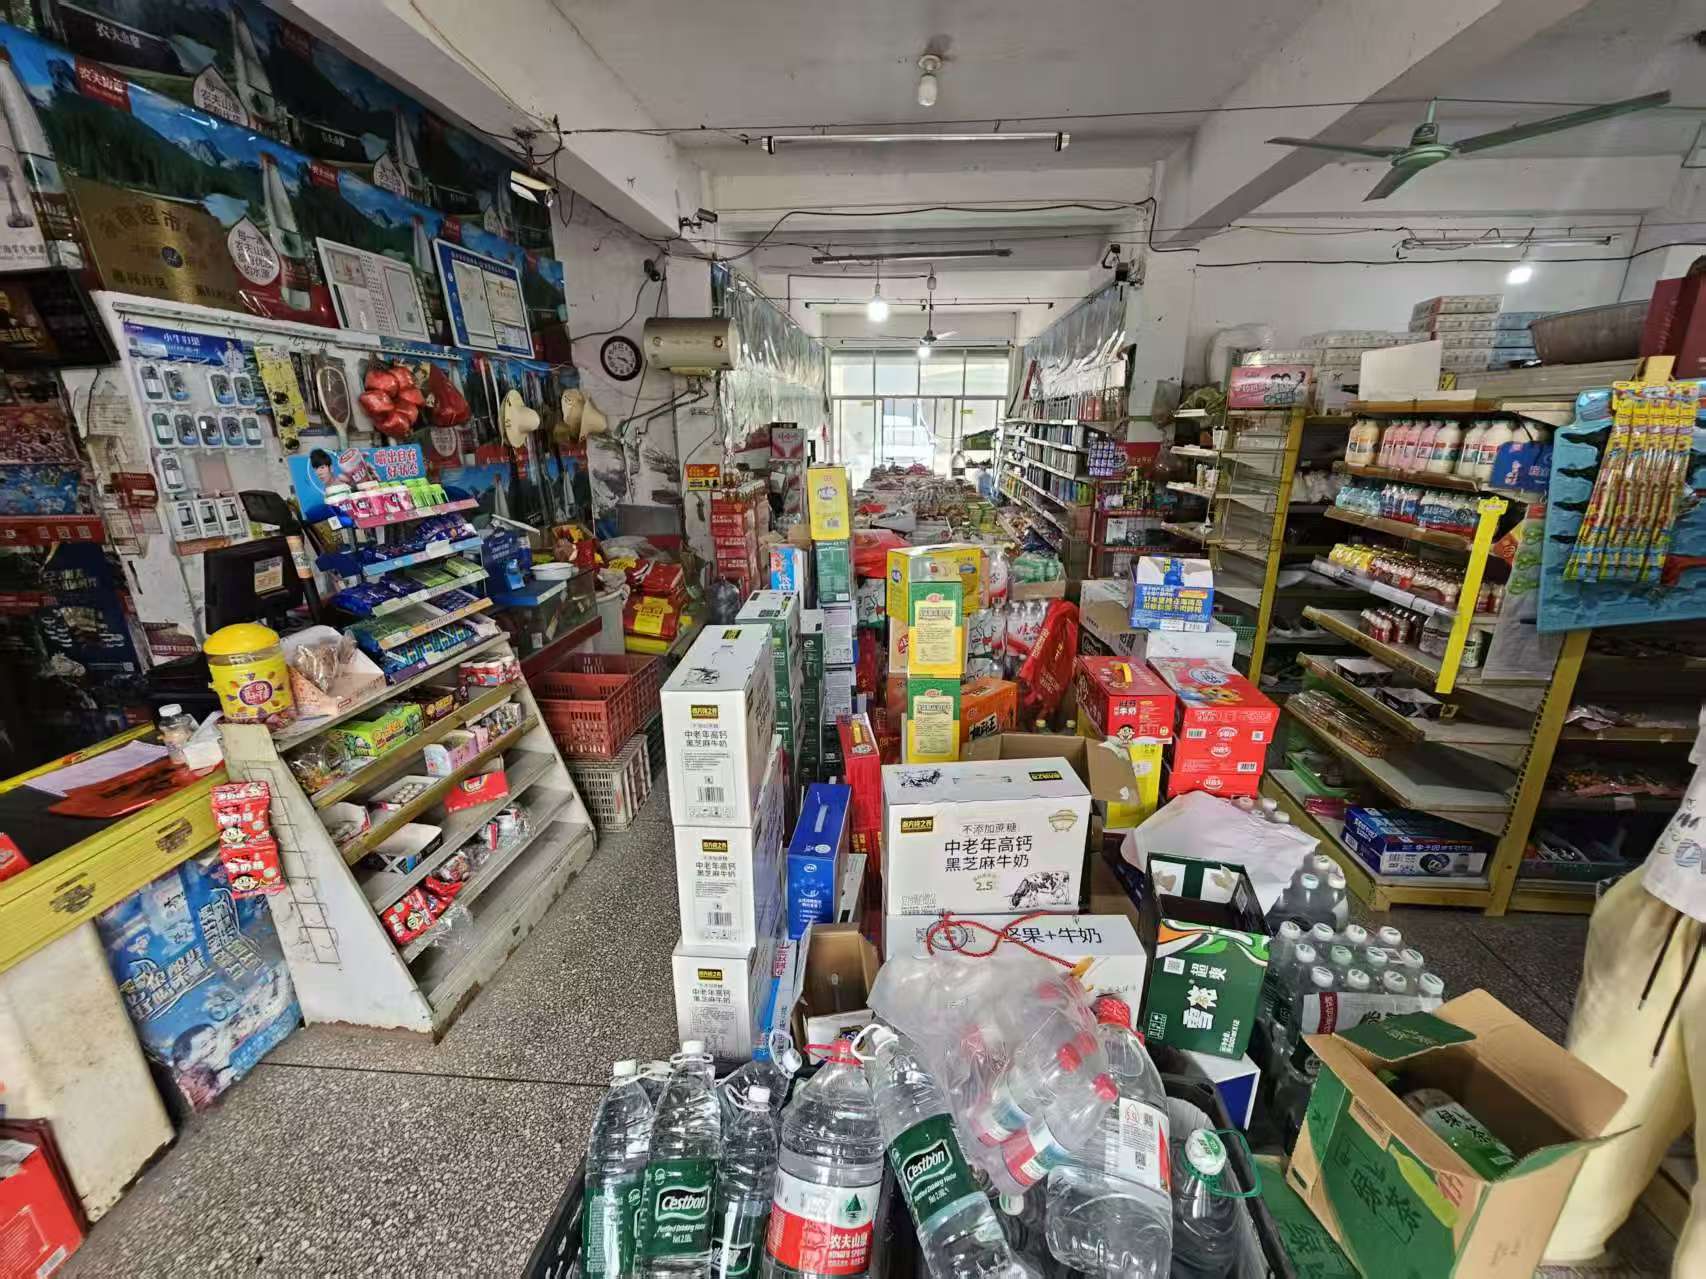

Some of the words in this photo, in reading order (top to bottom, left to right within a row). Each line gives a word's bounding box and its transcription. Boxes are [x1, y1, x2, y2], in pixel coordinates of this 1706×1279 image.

[95, 21, 141, 49] 农夫山泉
[78, 66, 124, 93] 农夫山泉
[684, 730, 728, 740] 中老年高钙
[685, 739, 728, 748] 黑芝麻牛奶
[962, 821, 1018, 836] 不添加蔗糖
[944, 835, 1033, 856] 中老年高钙
[695, 862, 737, 871] 中老年高钙
[944, 853, 1030, 873] 黑芝麻牛奶
[975, 880, 993, 892] 2.5
